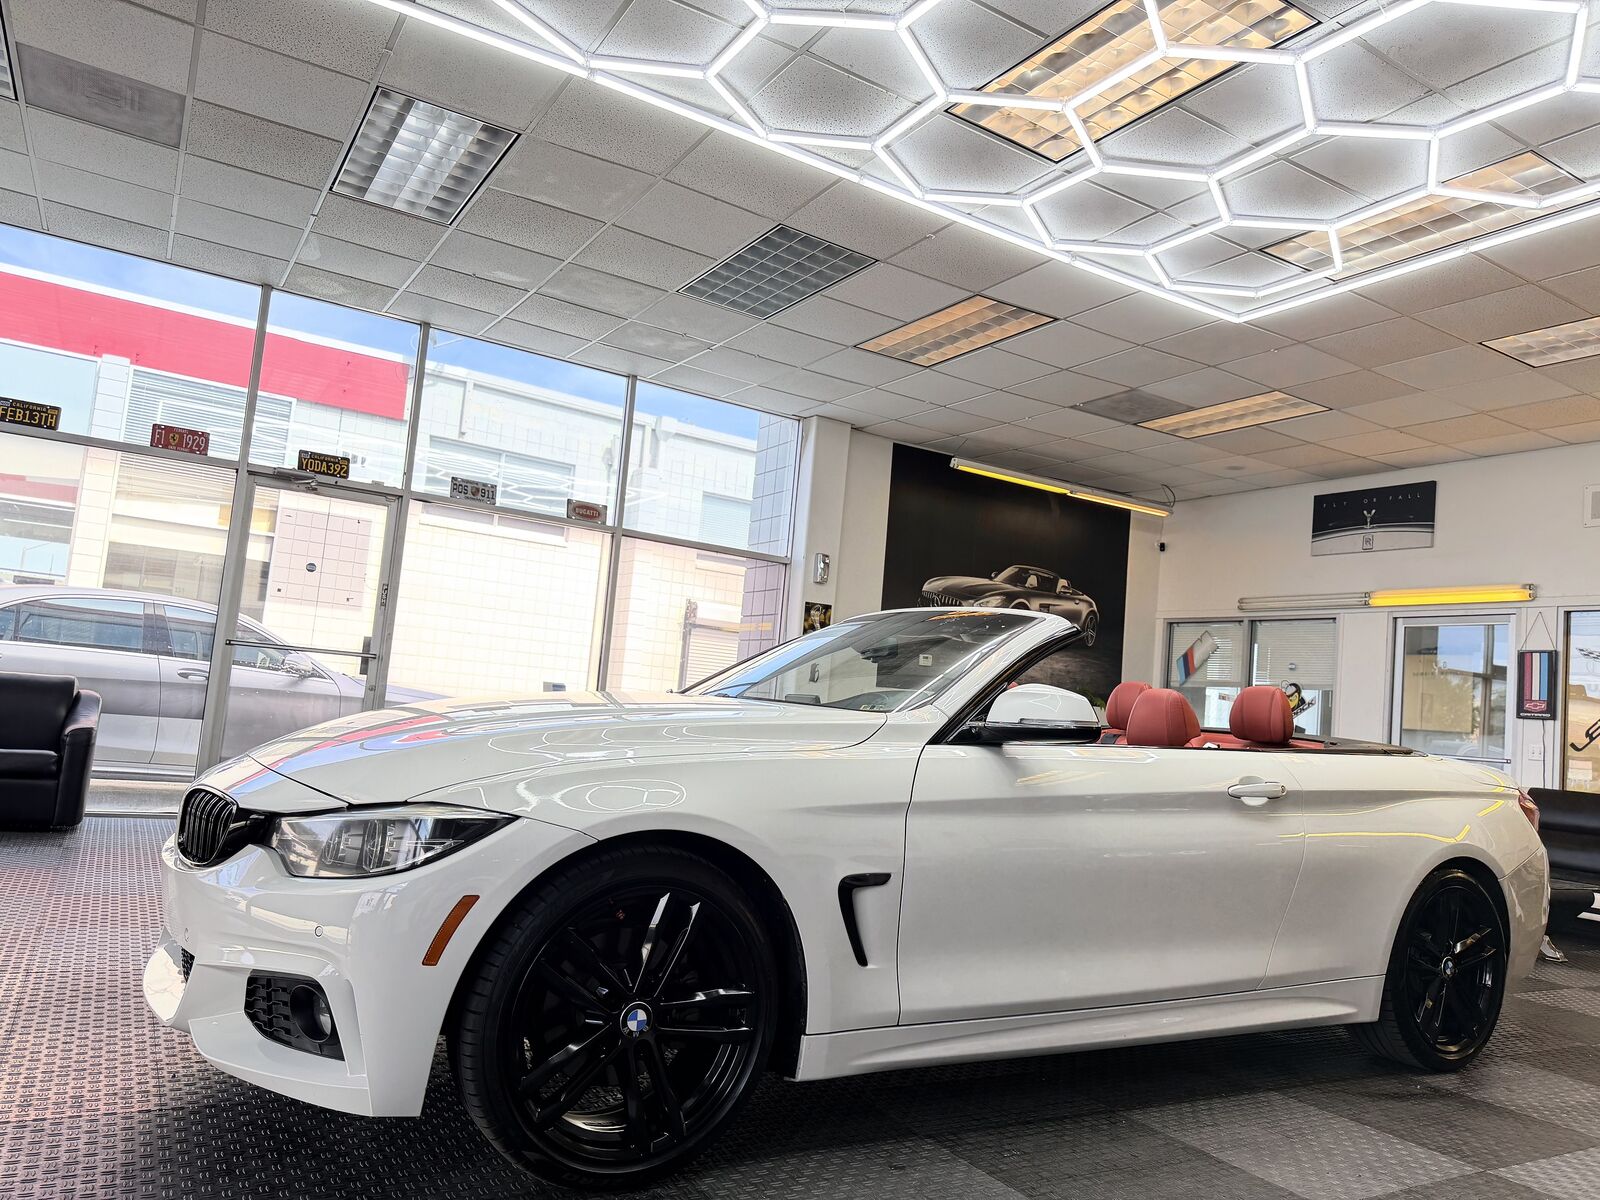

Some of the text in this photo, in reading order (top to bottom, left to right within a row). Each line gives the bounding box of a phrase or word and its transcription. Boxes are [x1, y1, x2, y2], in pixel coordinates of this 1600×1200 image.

[12, 402, 47, 412] CALIFORNIA
[0, 406, 56, 427] FEB13TH
[182, 434, 206, 451] 1929
[301, 457, 348, 476] YODA392
[481, 488, 496, 500] 911
[1389, 492, 1421, 501] FALL
